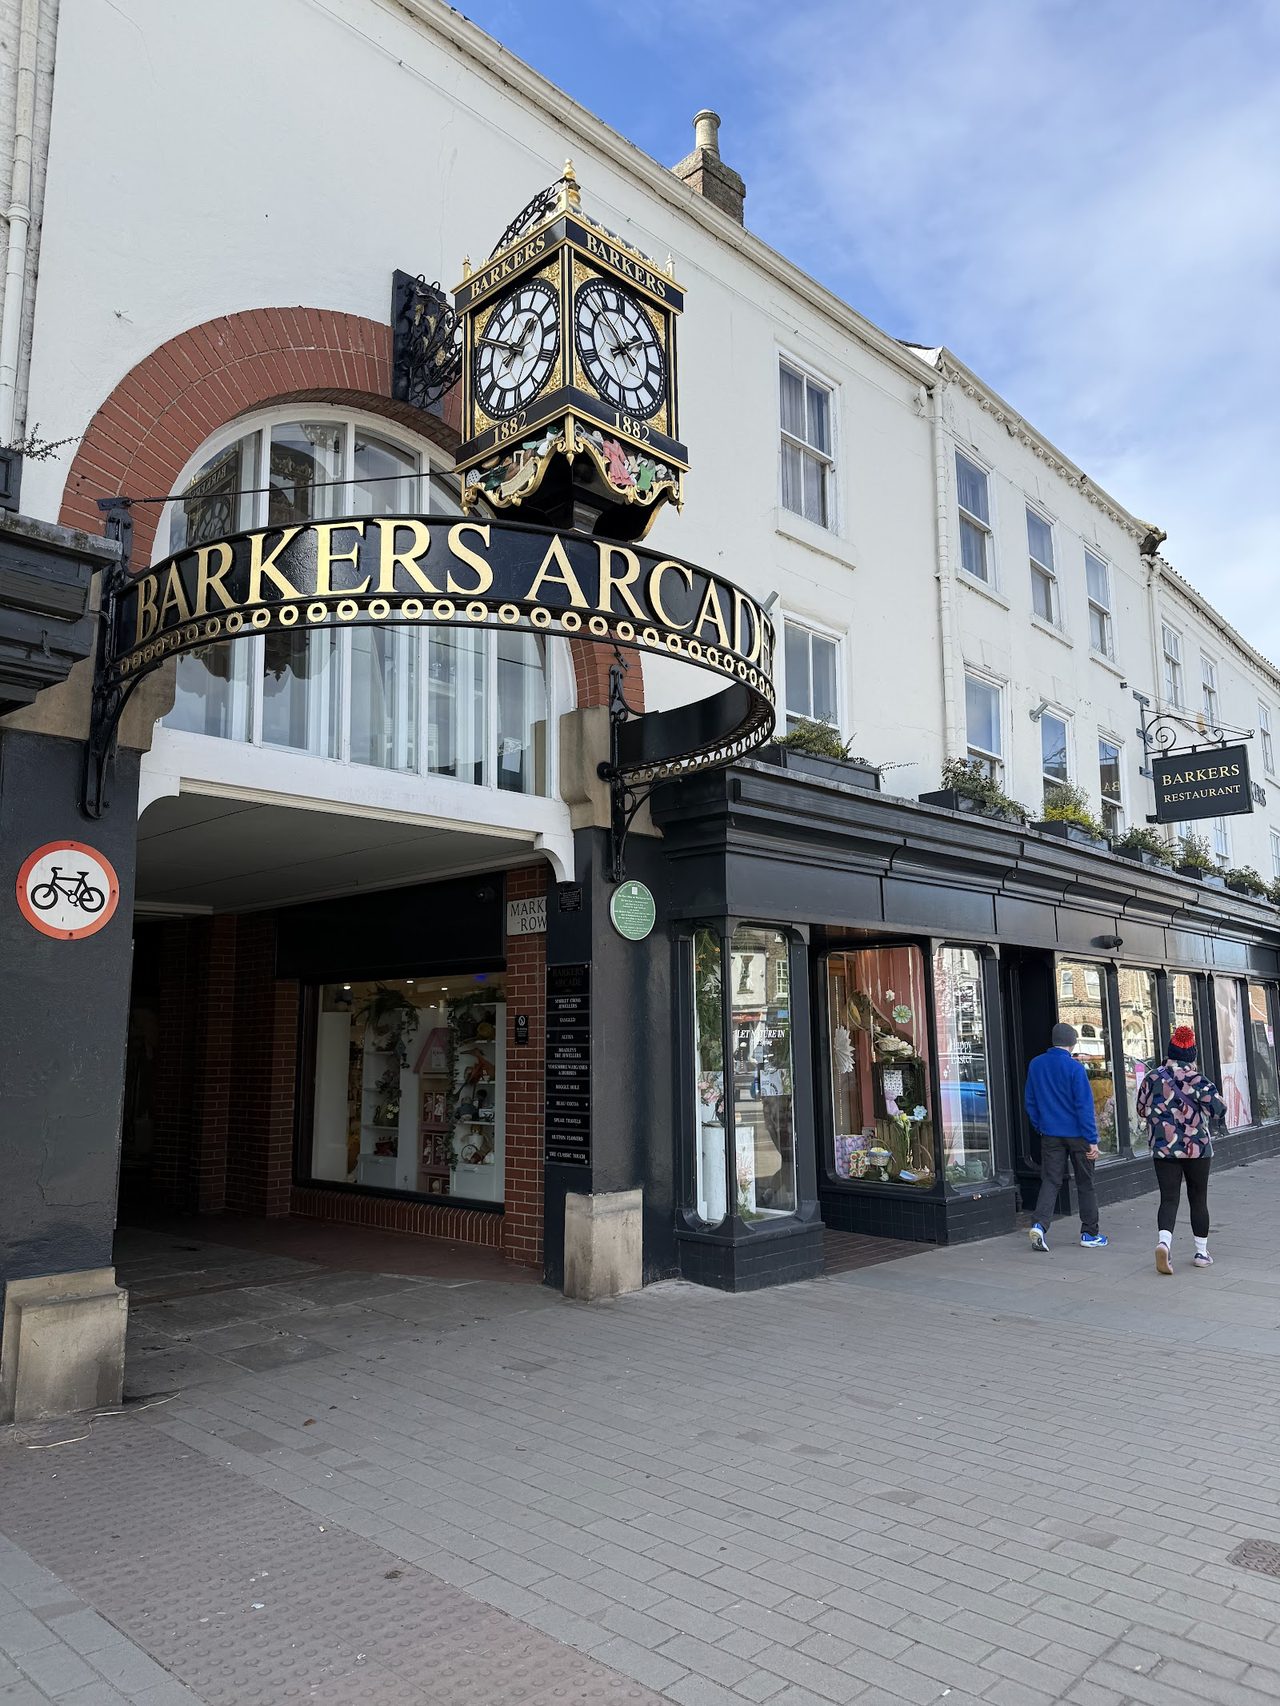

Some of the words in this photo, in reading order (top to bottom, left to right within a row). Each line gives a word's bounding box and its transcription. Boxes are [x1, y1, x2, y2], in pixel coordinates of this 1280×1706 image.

[470, 233, 546, 301] BARKERS
[586, 232, 666, 298] BARKERS
[492, 411, 527, 444] 1882
[614, 412, 651, 444] 1882
[134, 518, 494, 647] BARKERS
[523, 534, 776, 681] ARCADE
[1161, 764, 1240, 787] BARKERS
[1163, 784, 1241, 803] RESTAURANT
[521, 916, 547, 931] ROW
[750, 1029, 777, 1039] NTURE
